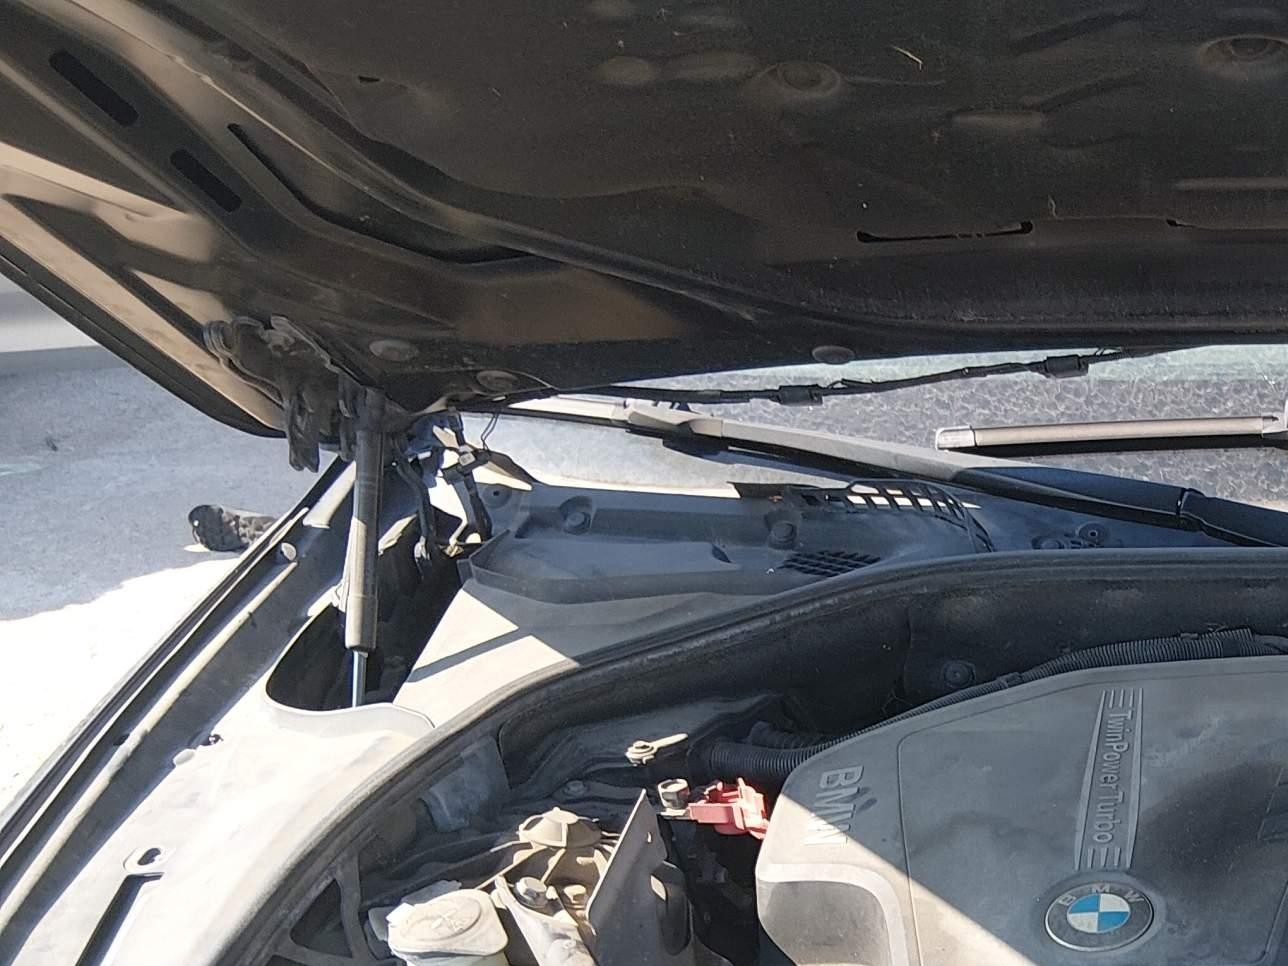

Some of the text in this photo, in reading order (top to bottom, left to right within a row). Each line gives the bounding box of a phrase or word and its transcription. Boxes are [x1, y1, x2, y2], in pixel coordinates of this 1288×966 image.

[804, 764, 865, 846] BMW
[1093, 709, 1133, 844] TwinPowerTurbo
[1058, 883, 1146, 907] BMW
